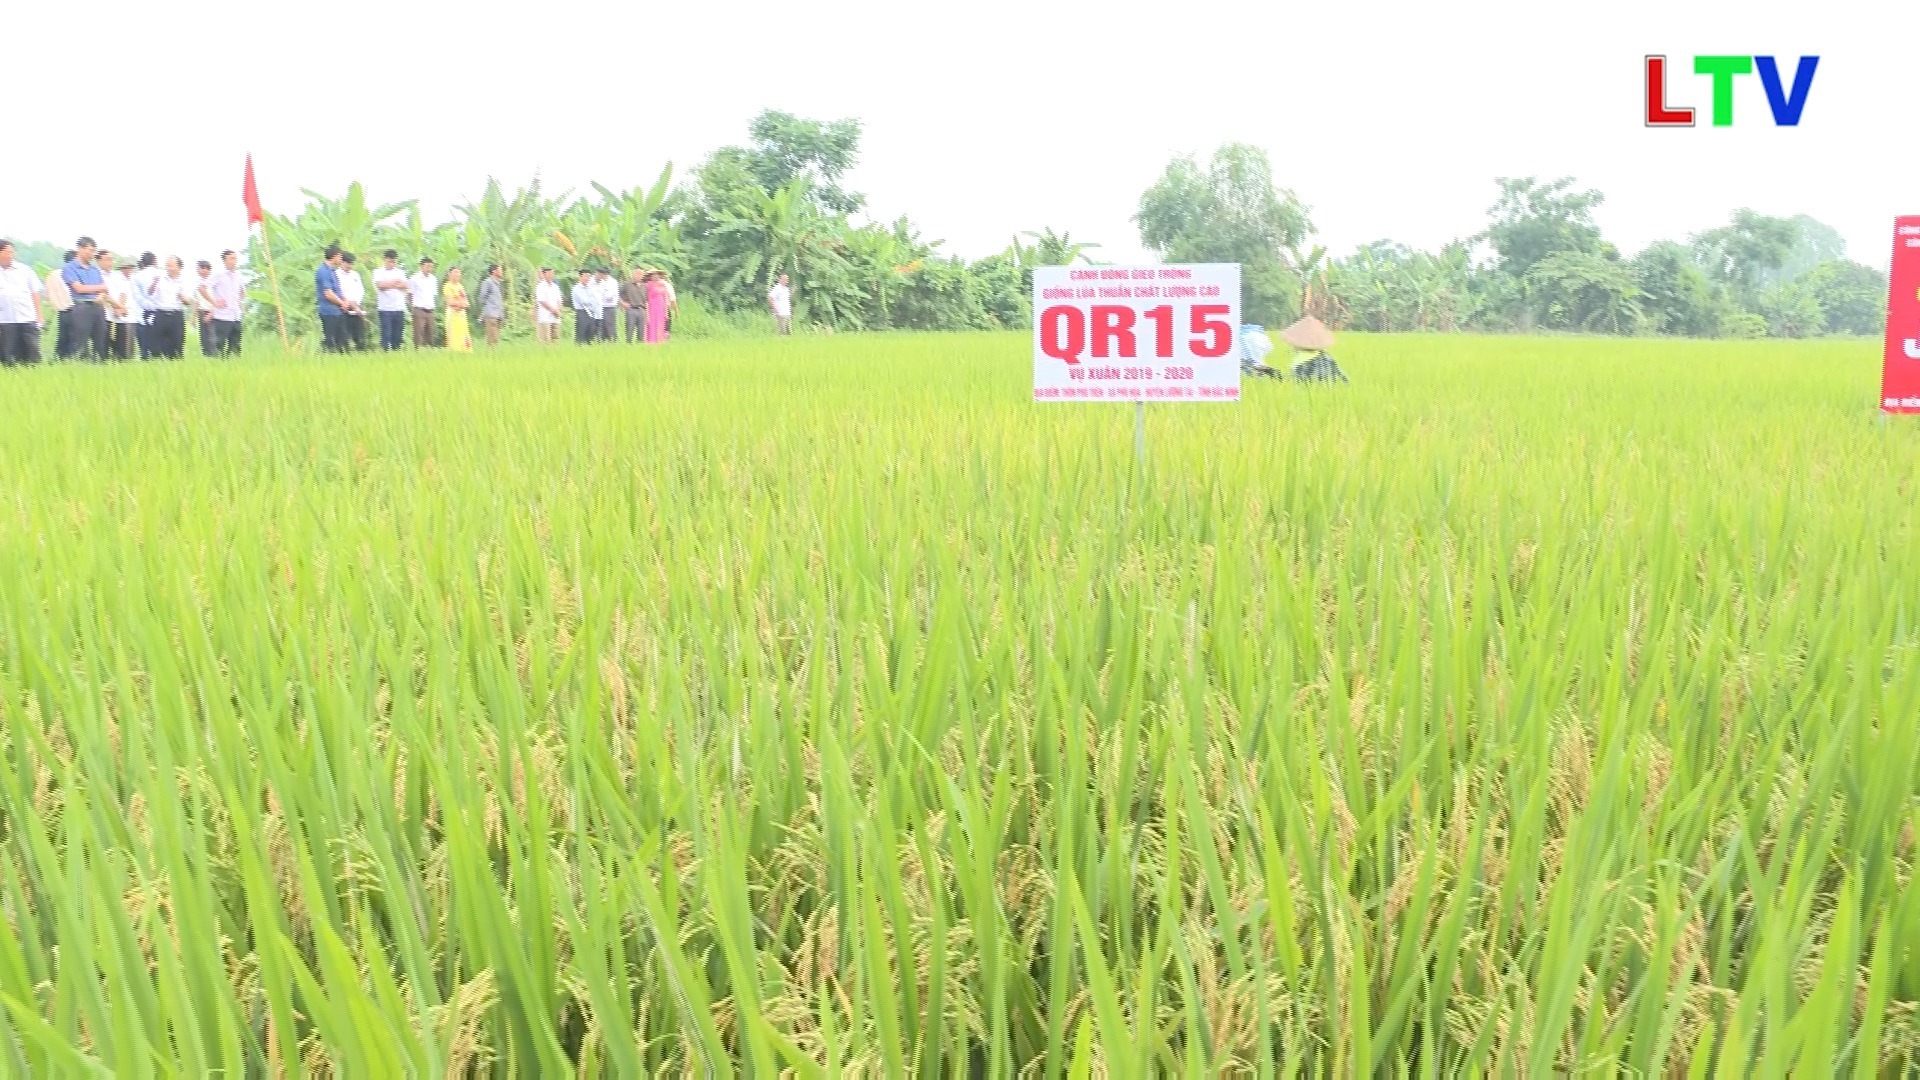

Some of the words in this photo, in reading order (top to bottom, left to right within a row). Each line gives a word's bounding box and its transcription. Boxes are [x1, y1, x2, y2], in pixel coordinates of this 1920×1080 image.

[1131, 269, 1155, 280] GIEO
[1042, 285, 1075, 299] GIỐNG
[1076, 286, 1096, 298] LÚA
[1134, 285, 1160, 298] CHẤT
[1162, 285, 1197, 299] LƯỢNG
[1199, 286, 1220, 297] CAO
[1040, 305, 1232, 365] QR15
[1069, 367, 1085, 383] VỤ
[1088, 365, 1121, 379] XUÂN
[1123, 366, 1153, 380] 2019
[1164, 366, 1194, 380] 2020
